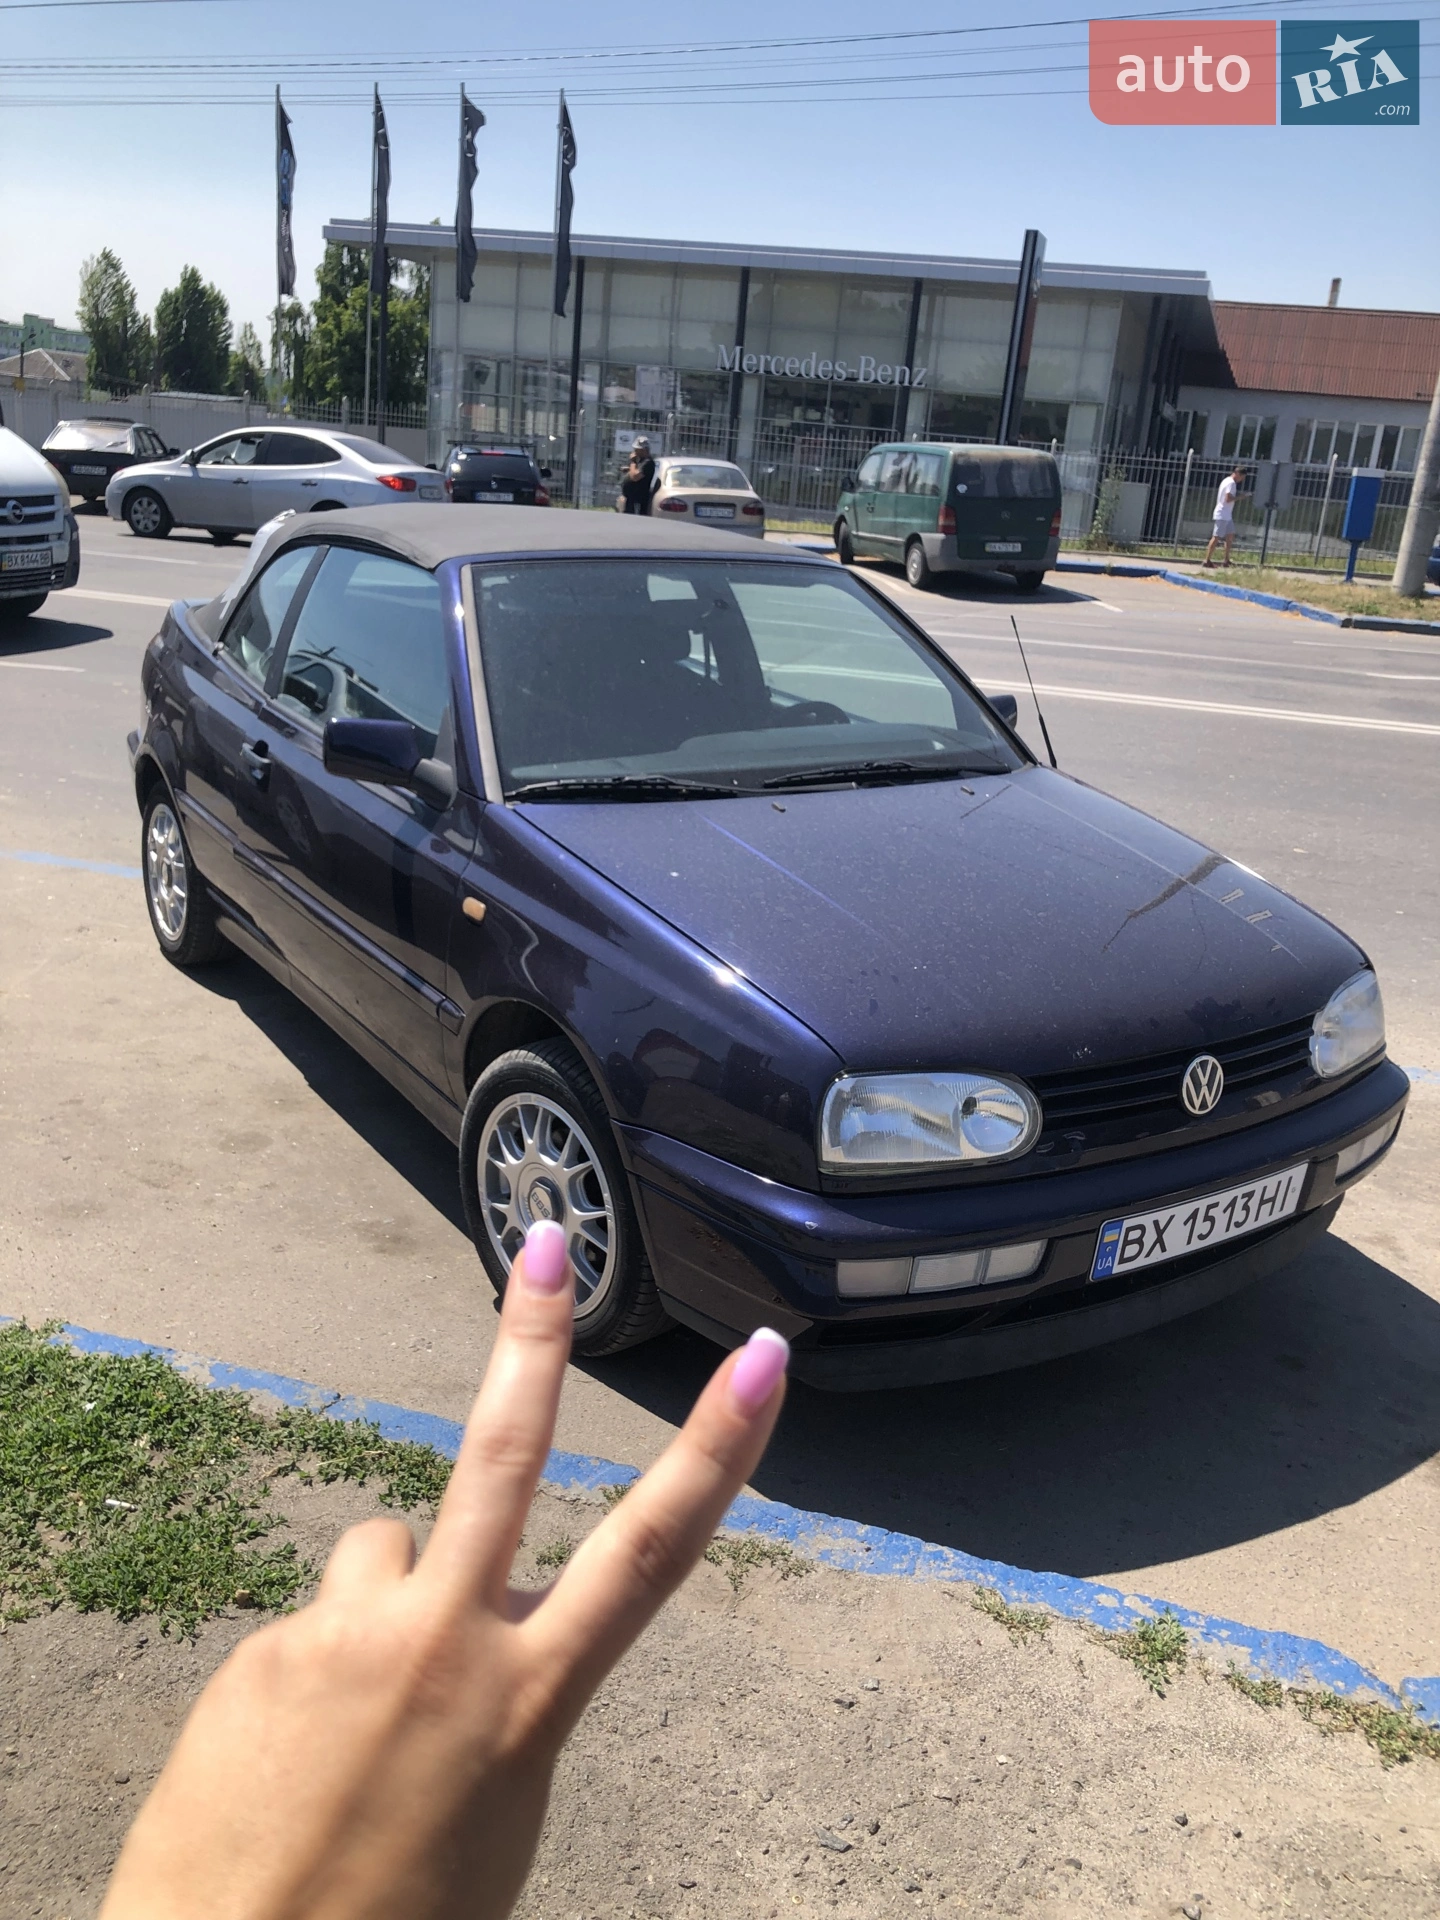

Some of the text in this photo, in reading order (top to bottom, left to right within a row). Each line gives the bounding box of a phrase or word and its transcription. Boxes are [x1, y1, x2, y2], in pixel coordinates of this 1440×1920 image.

[715, 344, 928, 388] Mercedes-Benz
[531, 1191, 551, 1218] BBS
[1097, 1257, 1113, 1270] UA
[1117, 1214, 1176, 1266] BX
